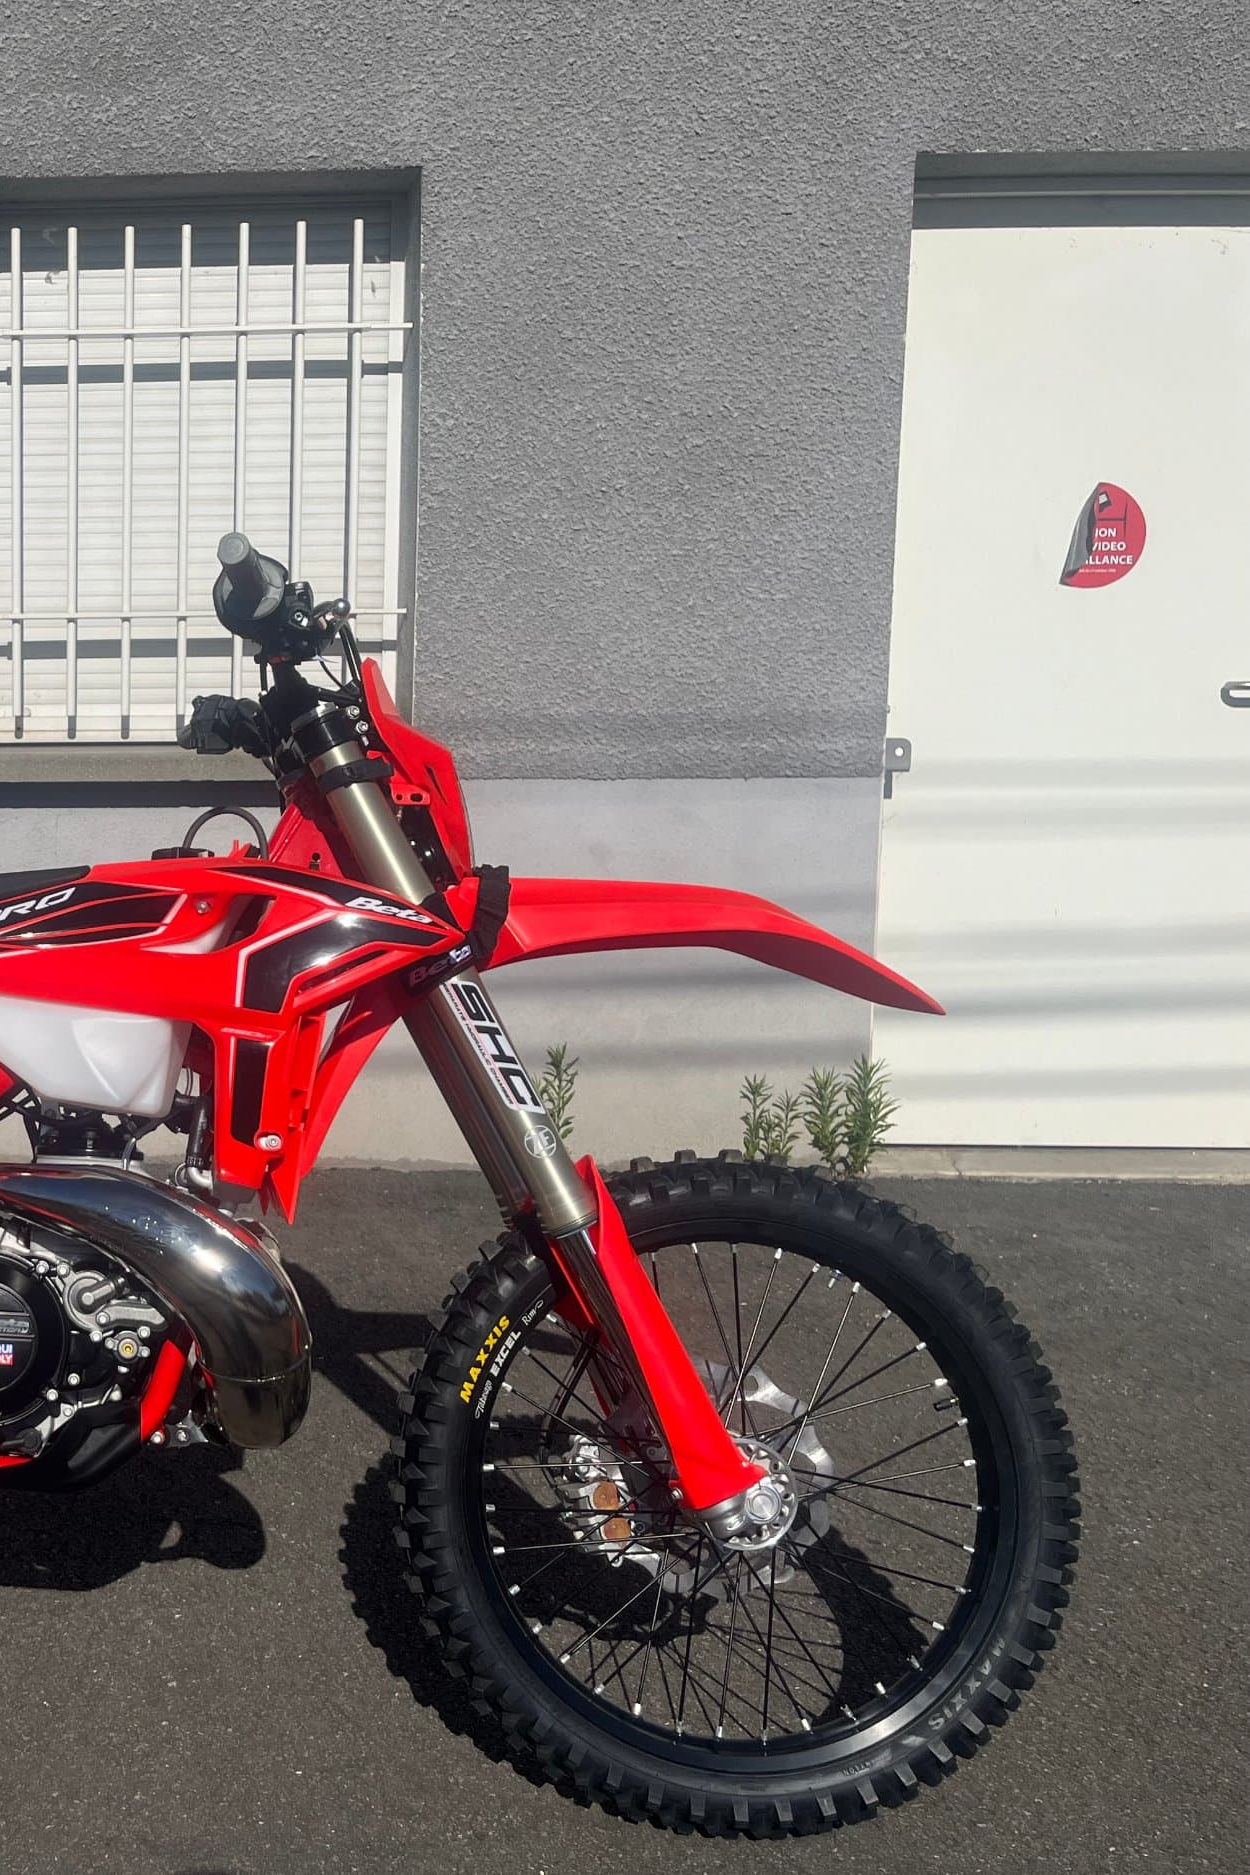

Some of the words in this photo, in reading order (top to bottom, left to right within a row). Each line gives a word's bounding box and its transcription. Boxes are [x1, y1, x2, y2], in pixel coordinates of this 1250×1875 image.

[345, 896, 433, 924] Beta
[451, 983, 542, 1107] SHC
[460, 1315, 510, 1404] MAXXIS
[490, 1331, 521, 1377] EXCEL
[928, 1636, 1006, 1731] MAXXIS
